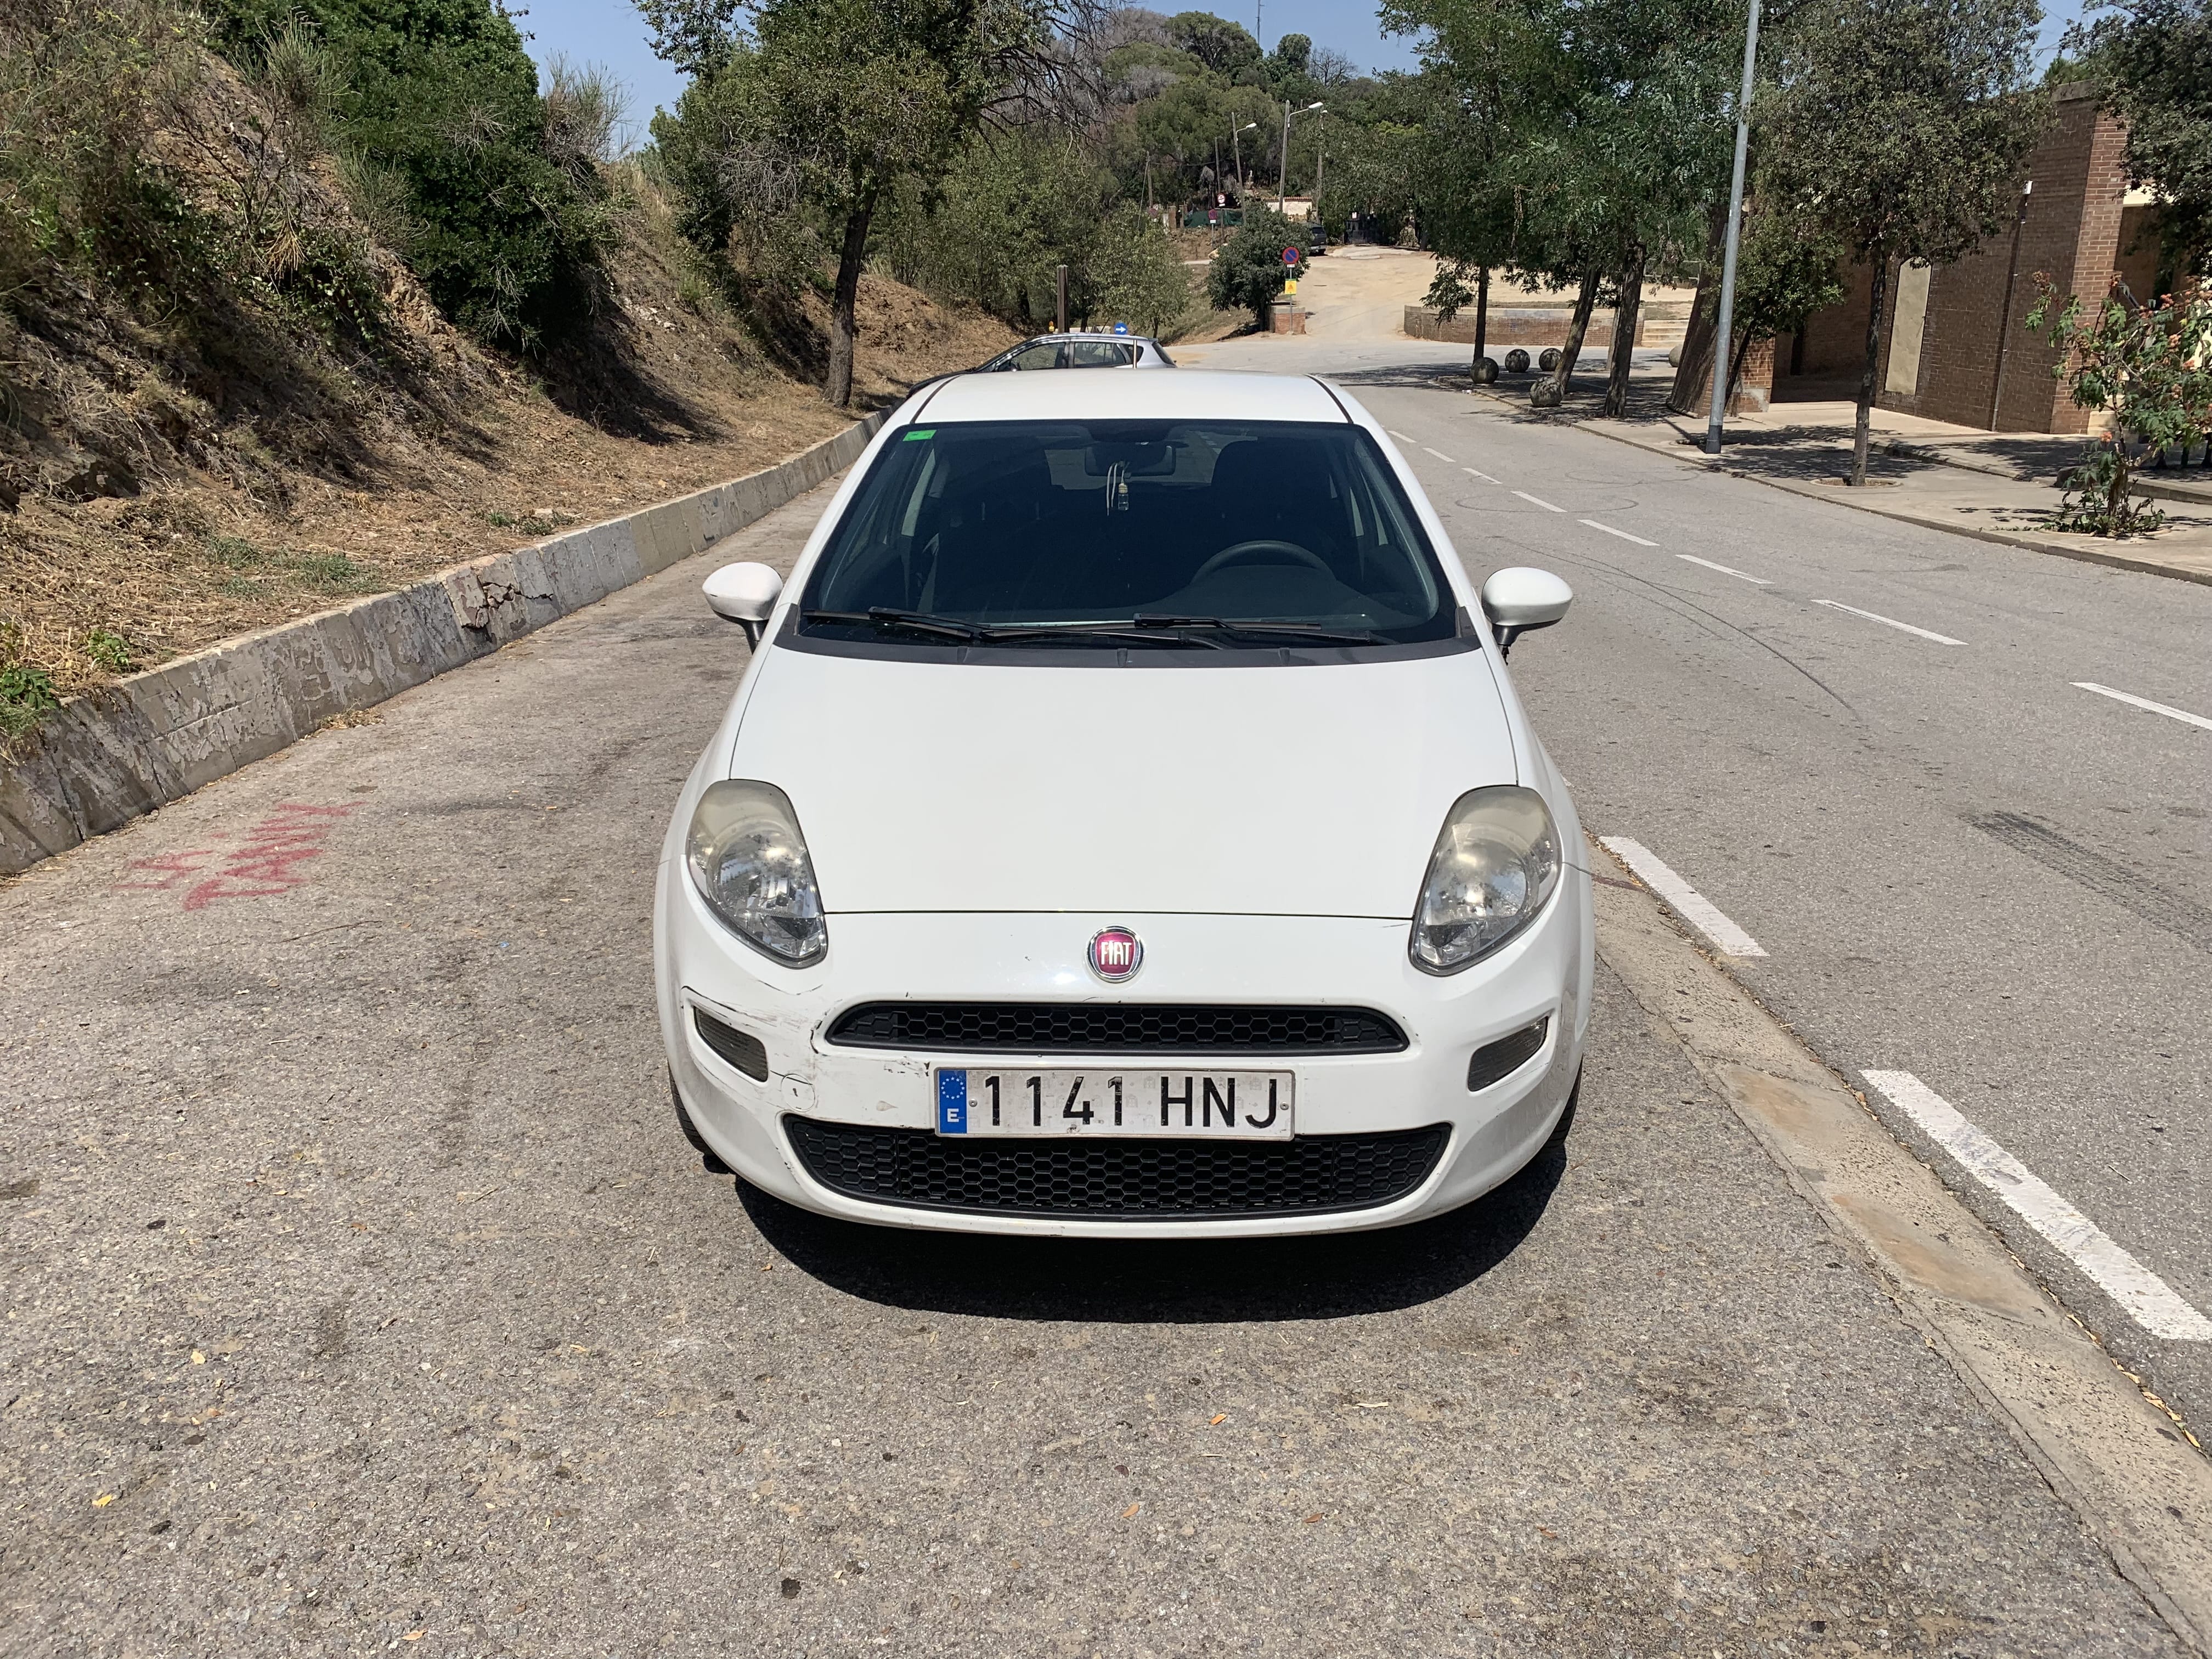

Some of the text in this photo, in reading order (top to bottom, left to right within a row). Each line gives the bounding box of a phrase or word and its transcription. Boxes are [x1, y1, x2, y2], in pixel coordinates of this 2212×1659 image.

[1101, 940, 1132, 966] FIAT
[947, 1108, 960, 1122] E
[985, 1076, 1277, 1129] 1141 HNJ
